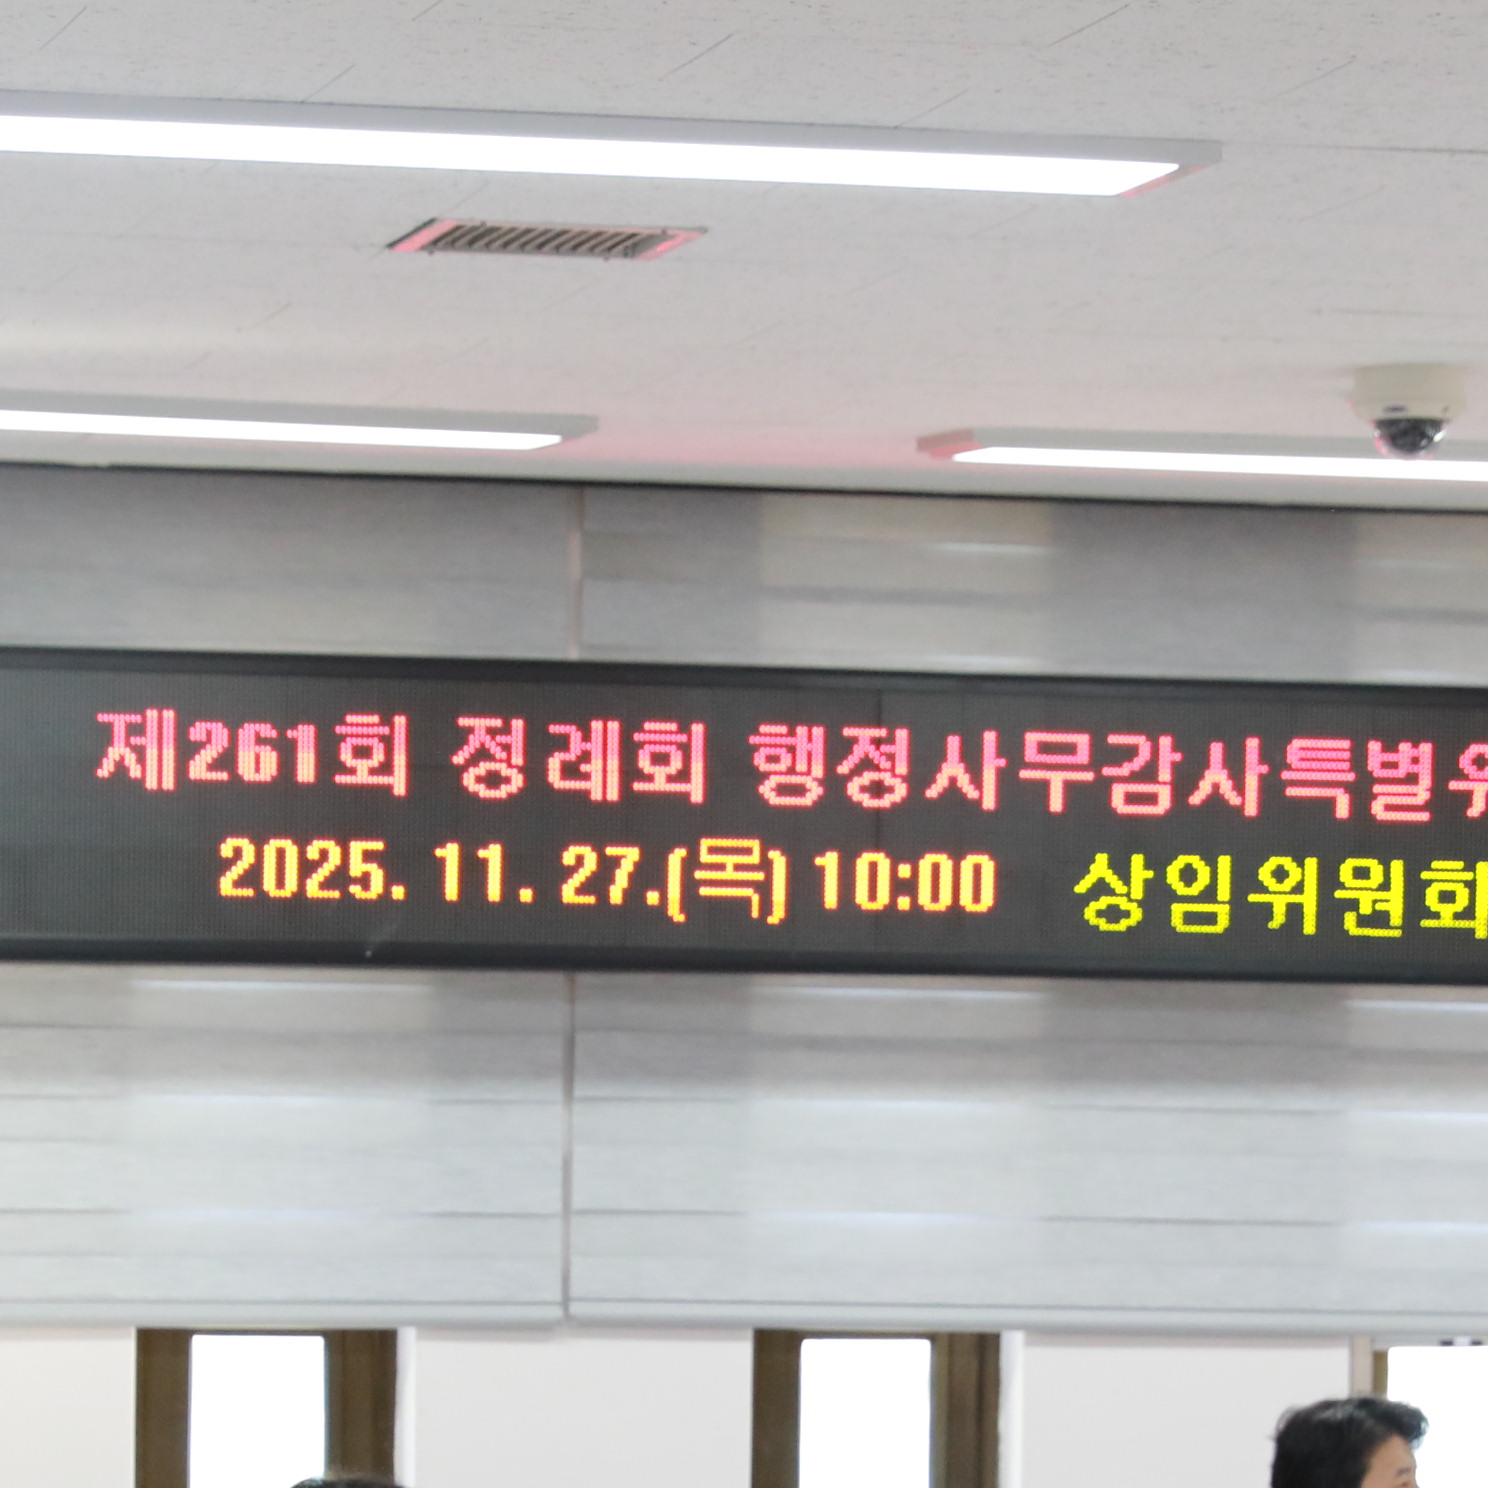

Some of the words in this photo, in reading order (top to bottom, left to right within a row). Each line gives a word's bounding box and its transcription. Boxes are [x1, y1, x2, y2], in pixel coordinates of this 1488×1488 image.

[95, 707, 407, 798] 제261회
[455, 715, 706, 804] 정례회
[218, 836, 406, 900] 2025.
[433, 840, 534, 903] 11.
[560, 837, 788, 925] 27.(목)
[813, 849, 996, 913] 10:00
